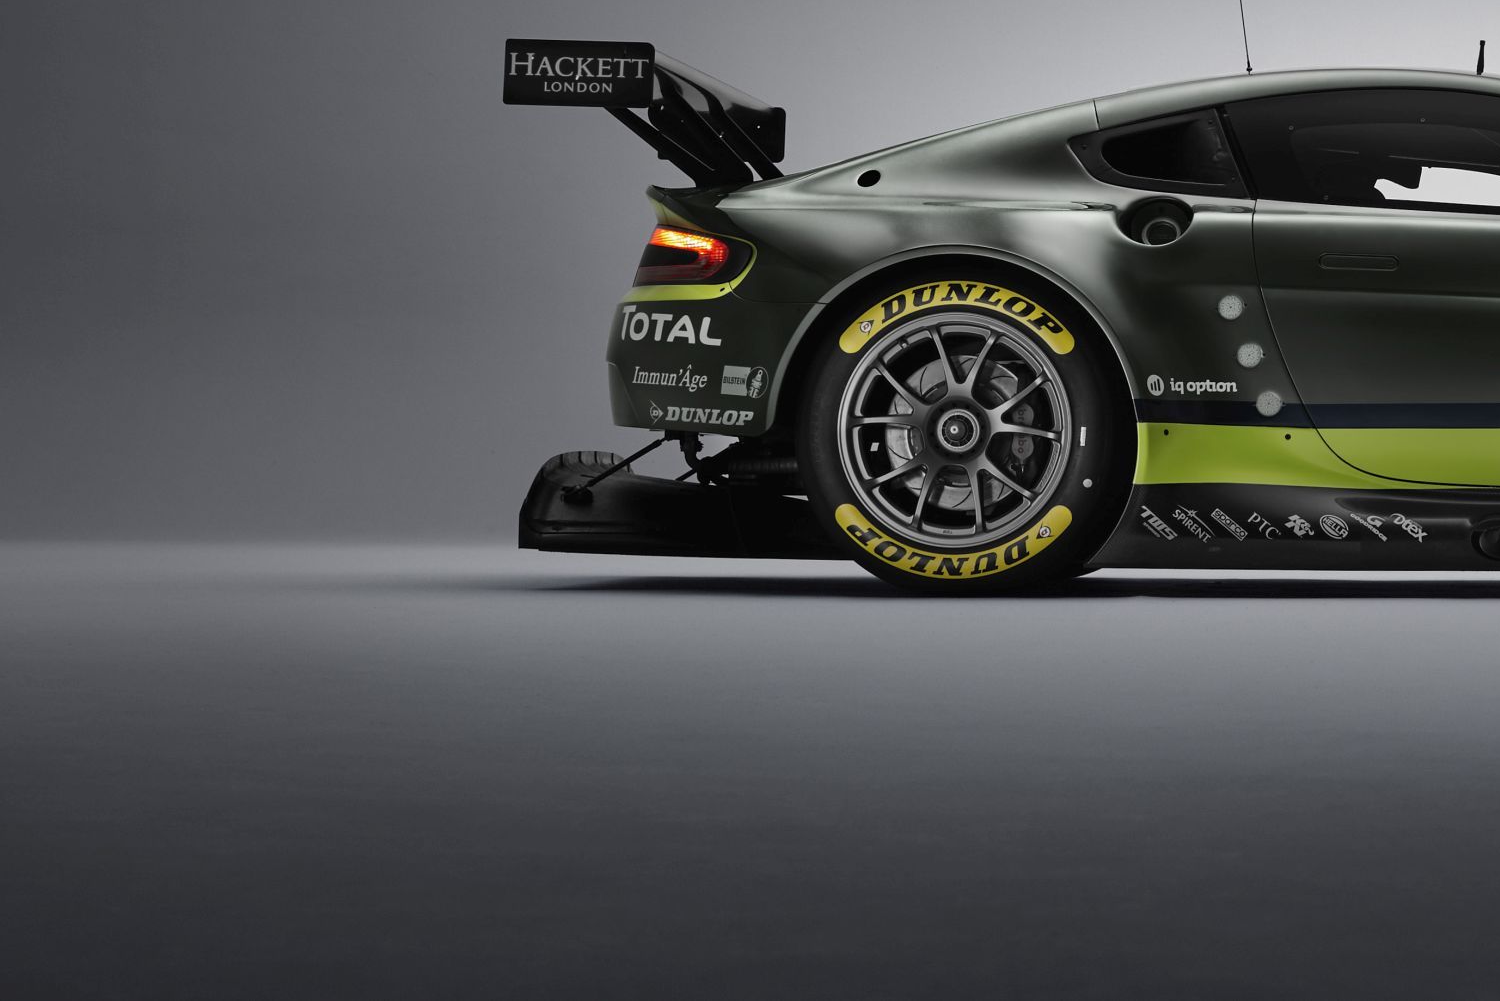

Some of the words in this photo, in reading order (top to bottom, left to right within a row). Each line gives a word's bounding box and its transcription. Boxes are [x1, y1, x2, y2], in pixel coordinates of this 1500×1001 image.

[509, 52, 649, 78] HACKETT
[544, 81, 612, 93] LONDON
[882, 284, 1062, 335] DUNLOP
[621, 305, 722, 346] TOTAL
[1170, 378, 1184, 394] iq
[1187, 380, 1237, 395] option
[665, 406, 754, 426] DUNLOP
[1172, 509, 1211, 543] SPIRENT
[1248, 512, 1279, 539] PTC
[1323, 517, 1349, 538] HELLA
[1350, 513, 1388, 542] GOODRIDGE
[846, 523, 1030, 576] DUNLOP
